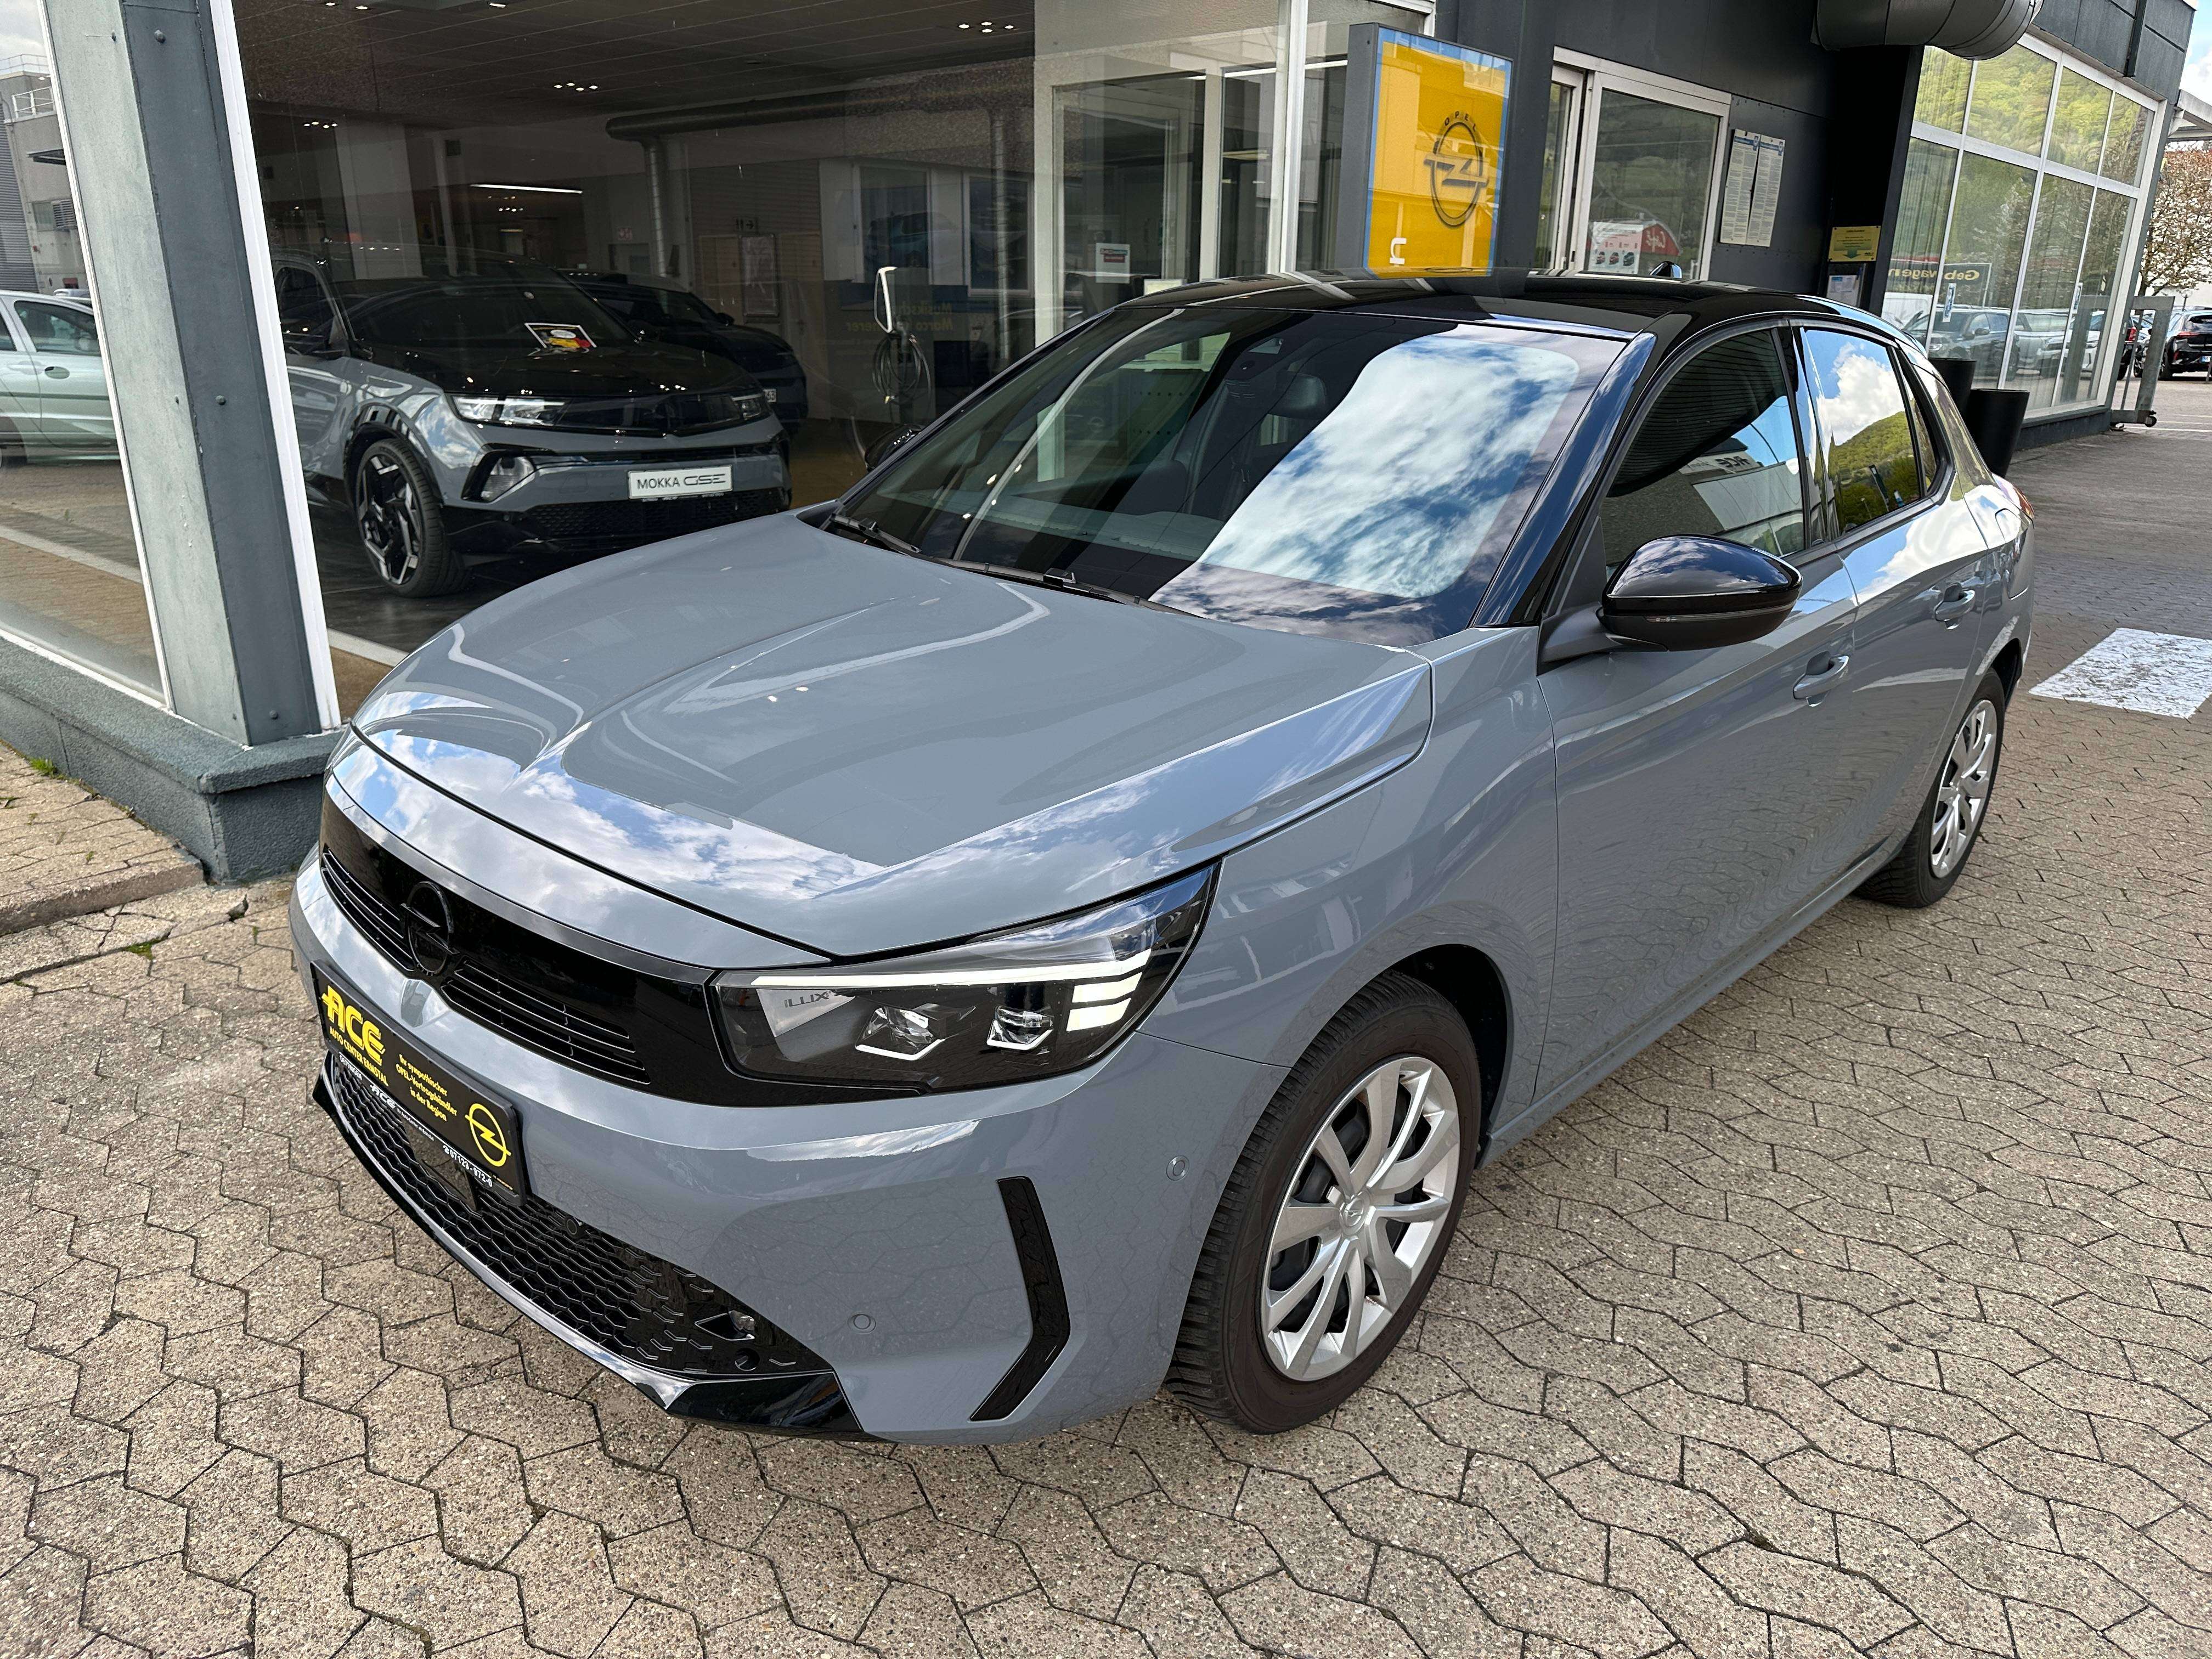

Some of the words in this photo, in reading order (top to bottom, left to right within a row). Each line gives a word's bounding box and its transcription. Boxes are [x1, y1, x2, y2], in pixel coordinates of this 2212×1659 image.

[1443, 111, 1477, 132] OPEL
[637, 477, 680, 490] MOKKA
[684, 473, 726, 486] GSE
[321, 985, 386, 1066] ACE
[330, 1026, 343, 1045] AUTO
[343, 1039, 364, 1064] CENTER
[363, 1057, 389, 1087] ERMSTAL
[408, 1062, 447, 1096] sympathischer
[369, 1085, 396, 1109] ACE
[416, 1092, 426, 1105] der
[426, 1099, 447, 1121] Region
